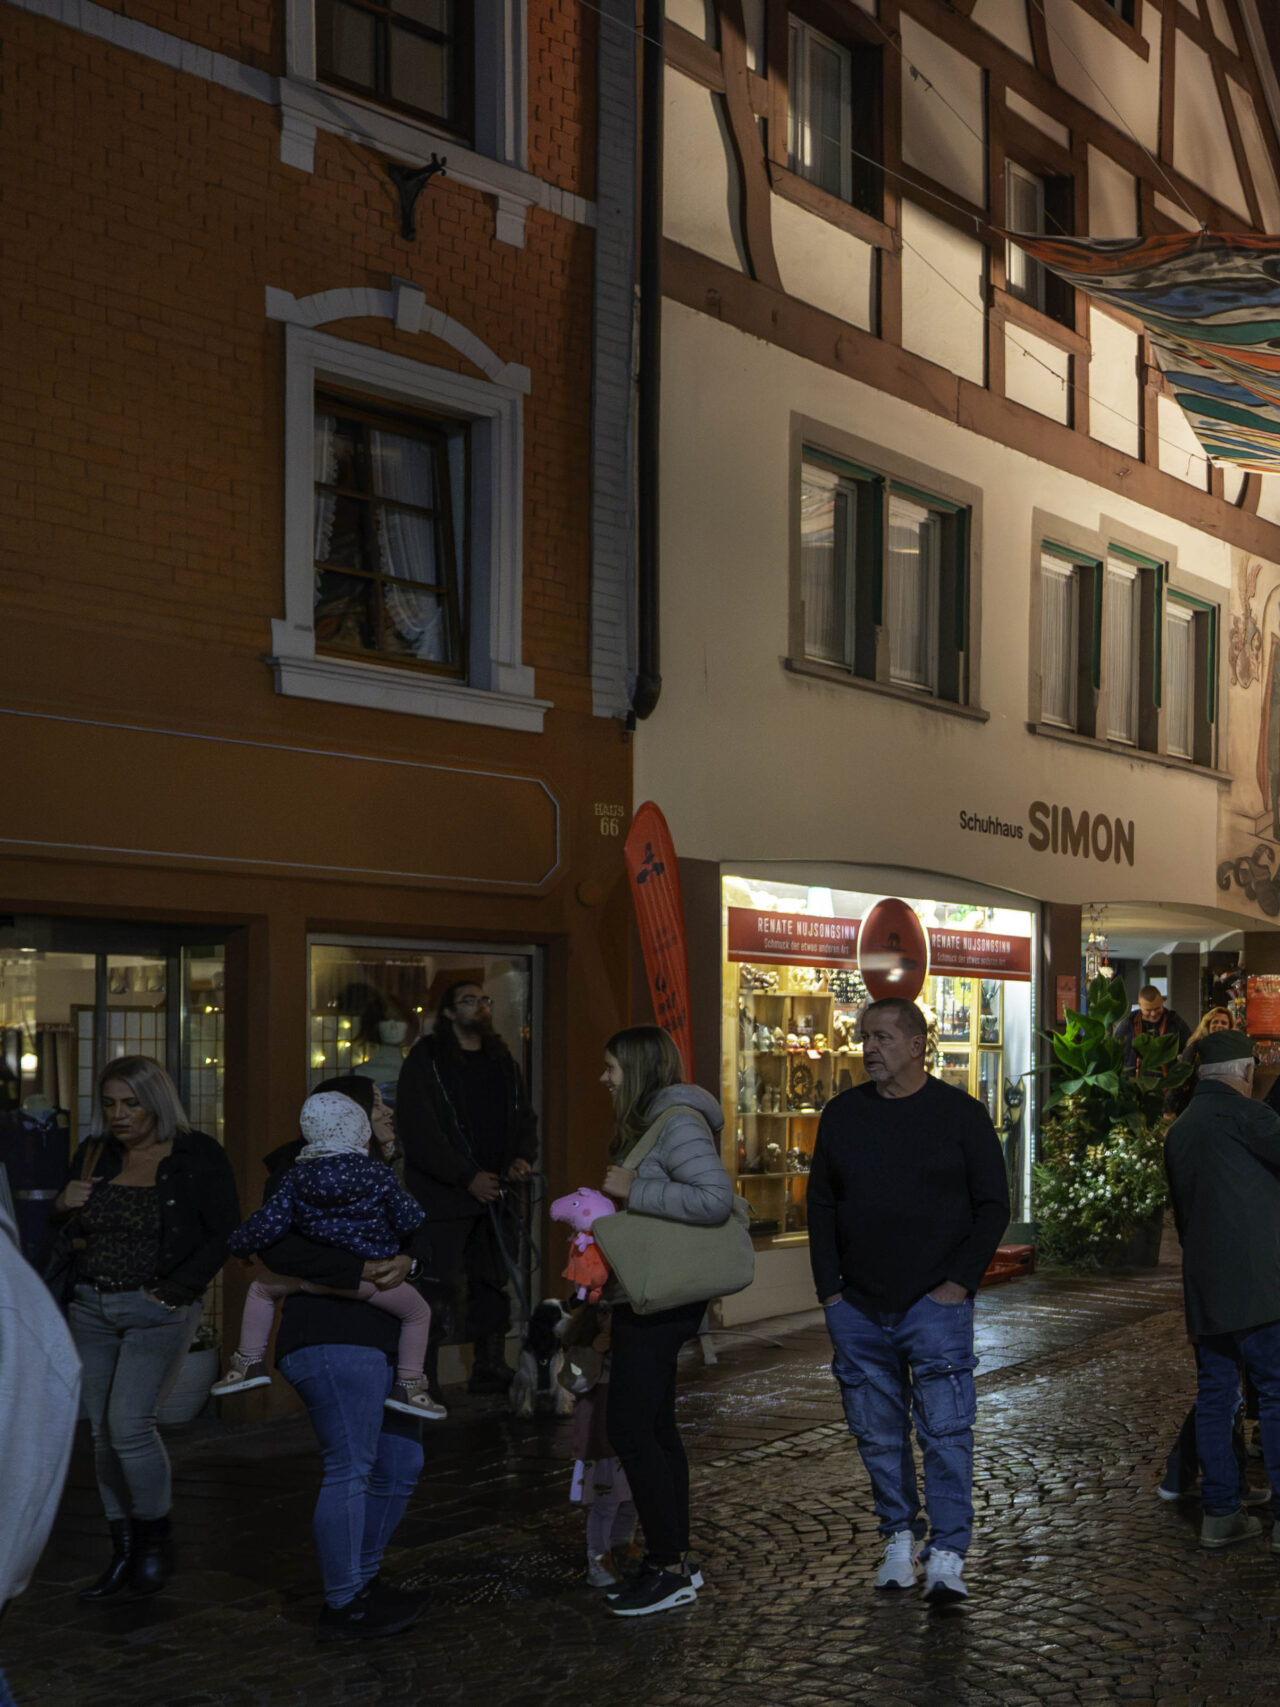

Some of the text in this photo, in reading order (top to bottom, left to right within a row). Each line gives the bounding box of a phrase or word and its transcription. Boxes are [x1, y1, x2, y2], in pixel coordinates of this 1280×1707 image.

[594, 802, 625, 817] HAUS
[600, 817, 620, 837] 66
[959, 800, 1135, 867] Schuhhaus SIMON
[757, 917, 793, 935] RENATE
[764, 938, 789, 950] Schmuck
[931, 934, 960, 950] RENATE
